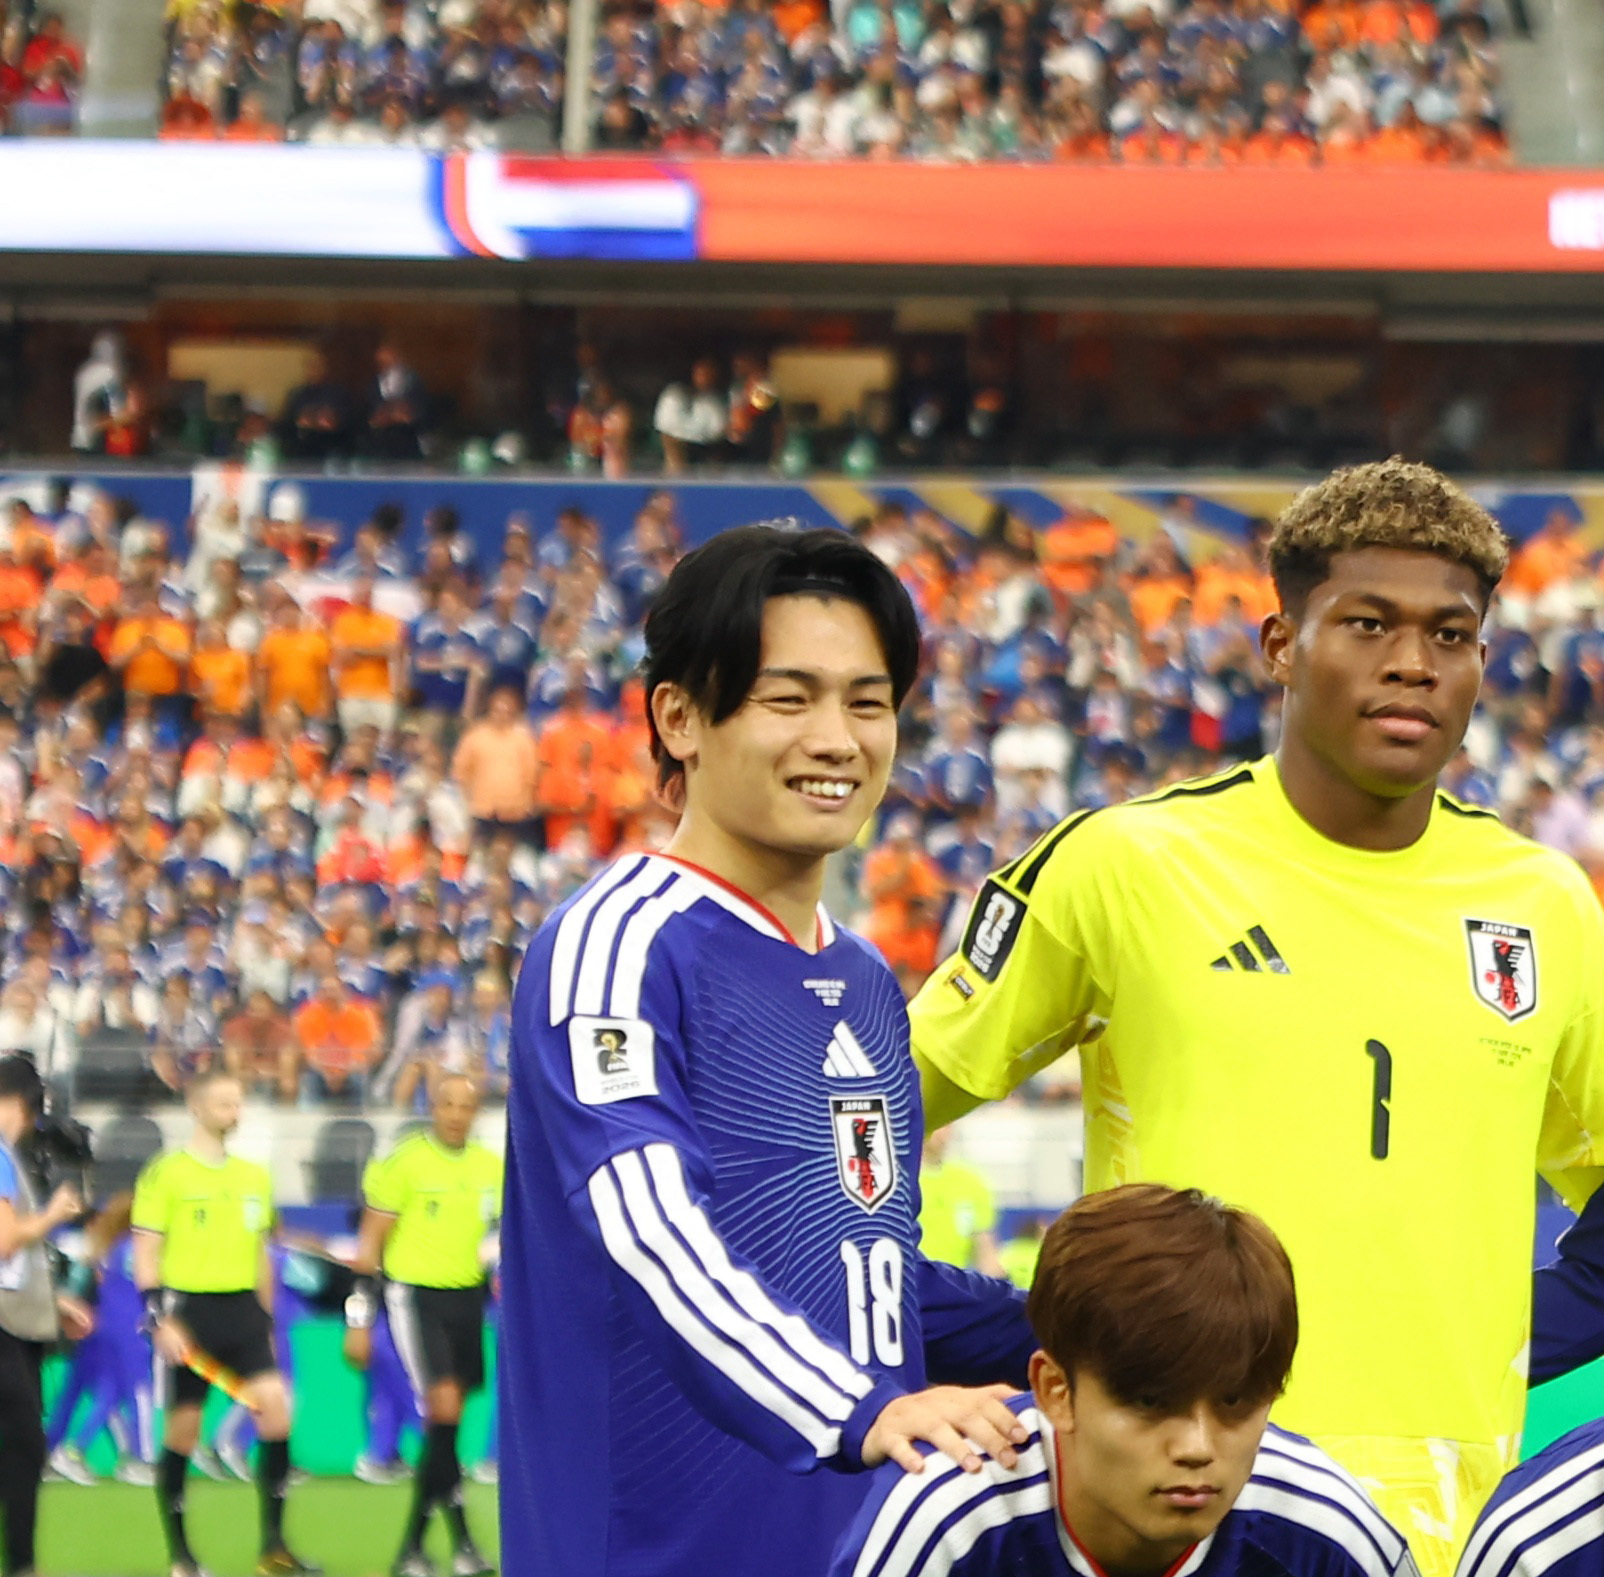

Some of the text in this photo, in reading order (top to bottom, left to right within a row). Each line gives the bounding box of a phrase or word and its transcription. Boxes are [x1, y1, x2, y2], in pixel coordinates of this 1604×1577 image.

[1480, 922, 1518, 937] JAPAN
[842, 1101, 872, 1111] JAPAN
[1365, 1039, 1393, 1161] 1
[841, 1237, 903, 1368] 18
